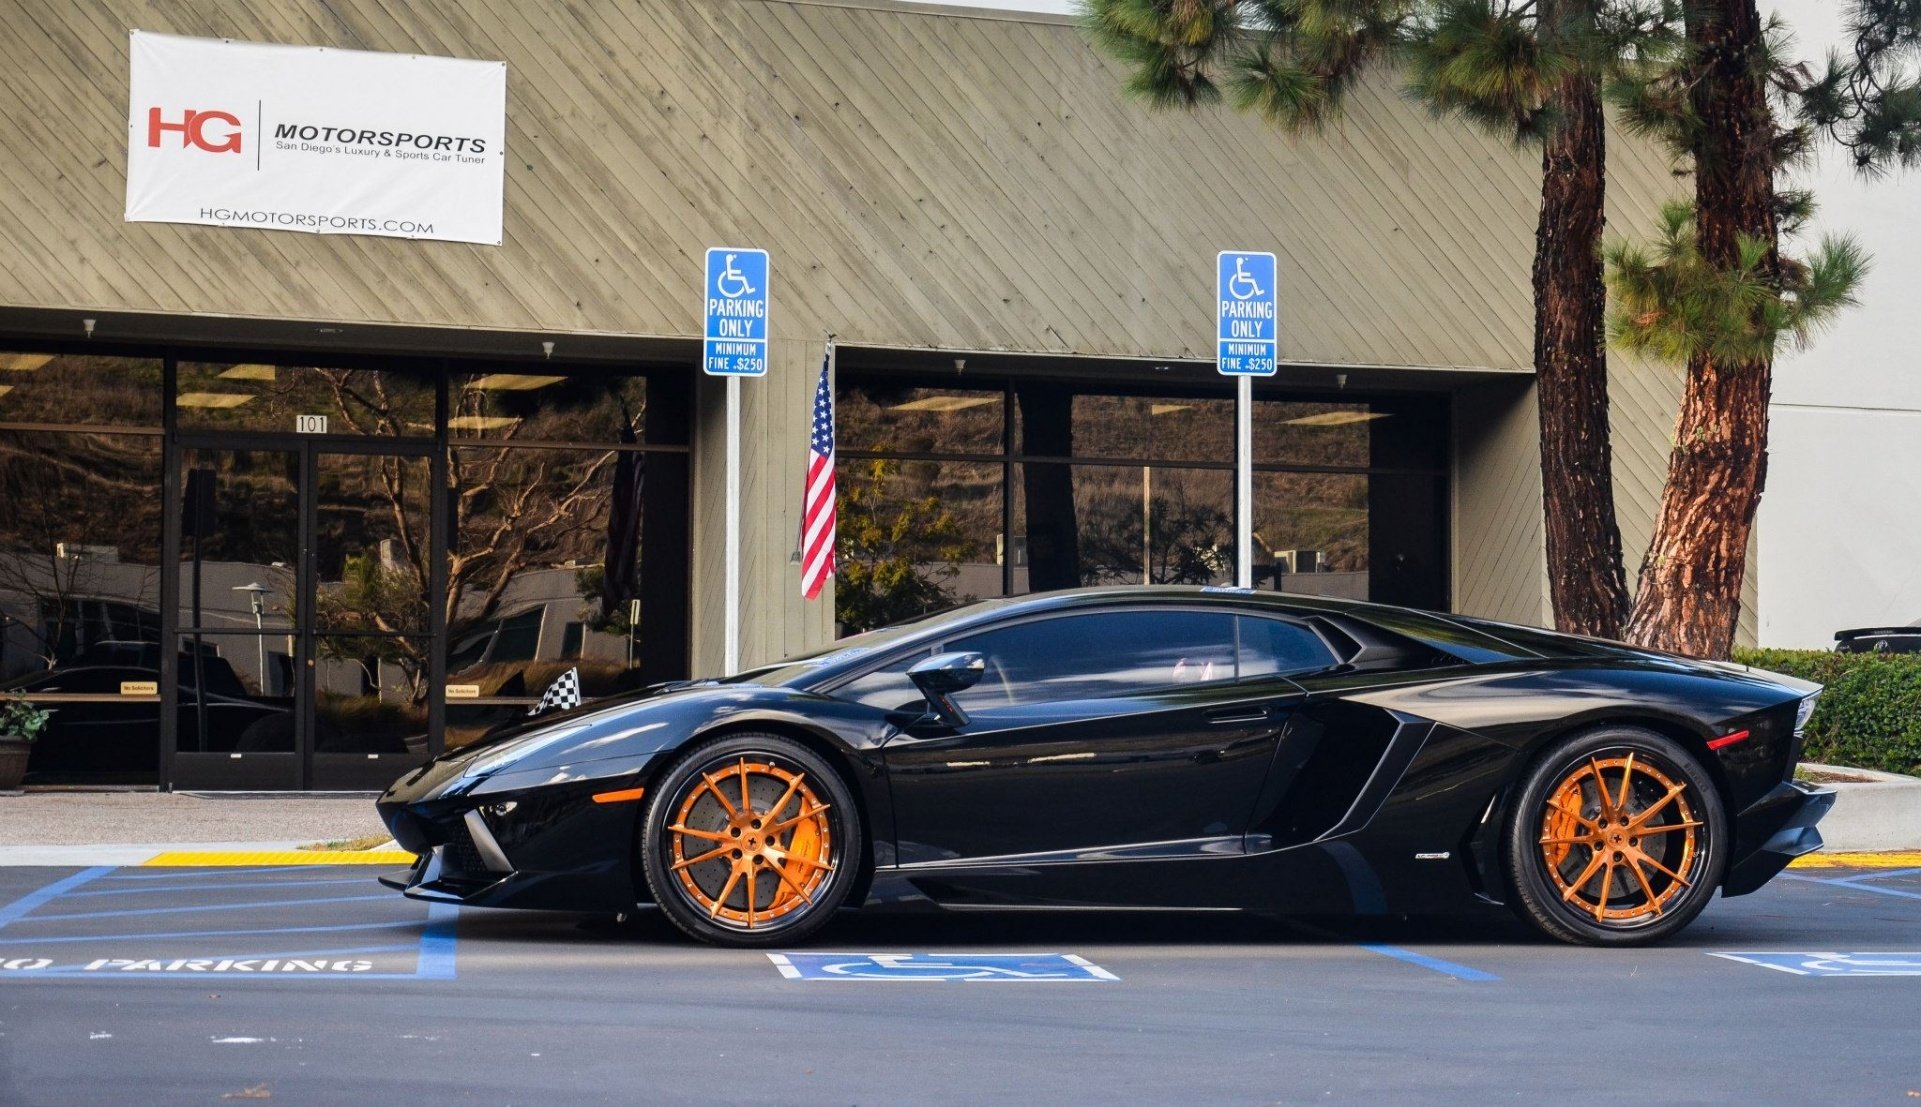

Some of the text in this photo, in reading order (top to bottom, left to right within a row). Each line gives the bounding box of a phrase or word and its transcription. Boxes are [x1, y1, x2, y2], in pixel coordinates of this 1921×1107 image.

[148, 107, 242, 154] HG
[274, 124, 487, 154] MOTORSPORTS
[275, 140, 486, 165] San Diego's Luxury & Sports Car Tuner
[200, 207, 434, 234] HGMOTORSPORTS.COM
[709, 298, 764, 318] PARKING
[1221, 300, 1273, 319] PARKING
[719, 318, 753, 338] ONLY
[1231, 320, 1263, 338] ONLY
[715, 342, 757, 356] MINIMUM
[1228, 343, 1267, 356] MINIMUM
[708, 356, 730, 370] FINE
[1221, 357, 1242, 370] FINE
[300, 416, 324, 432] 101
[0, 958, 373, 972] O PARKING
